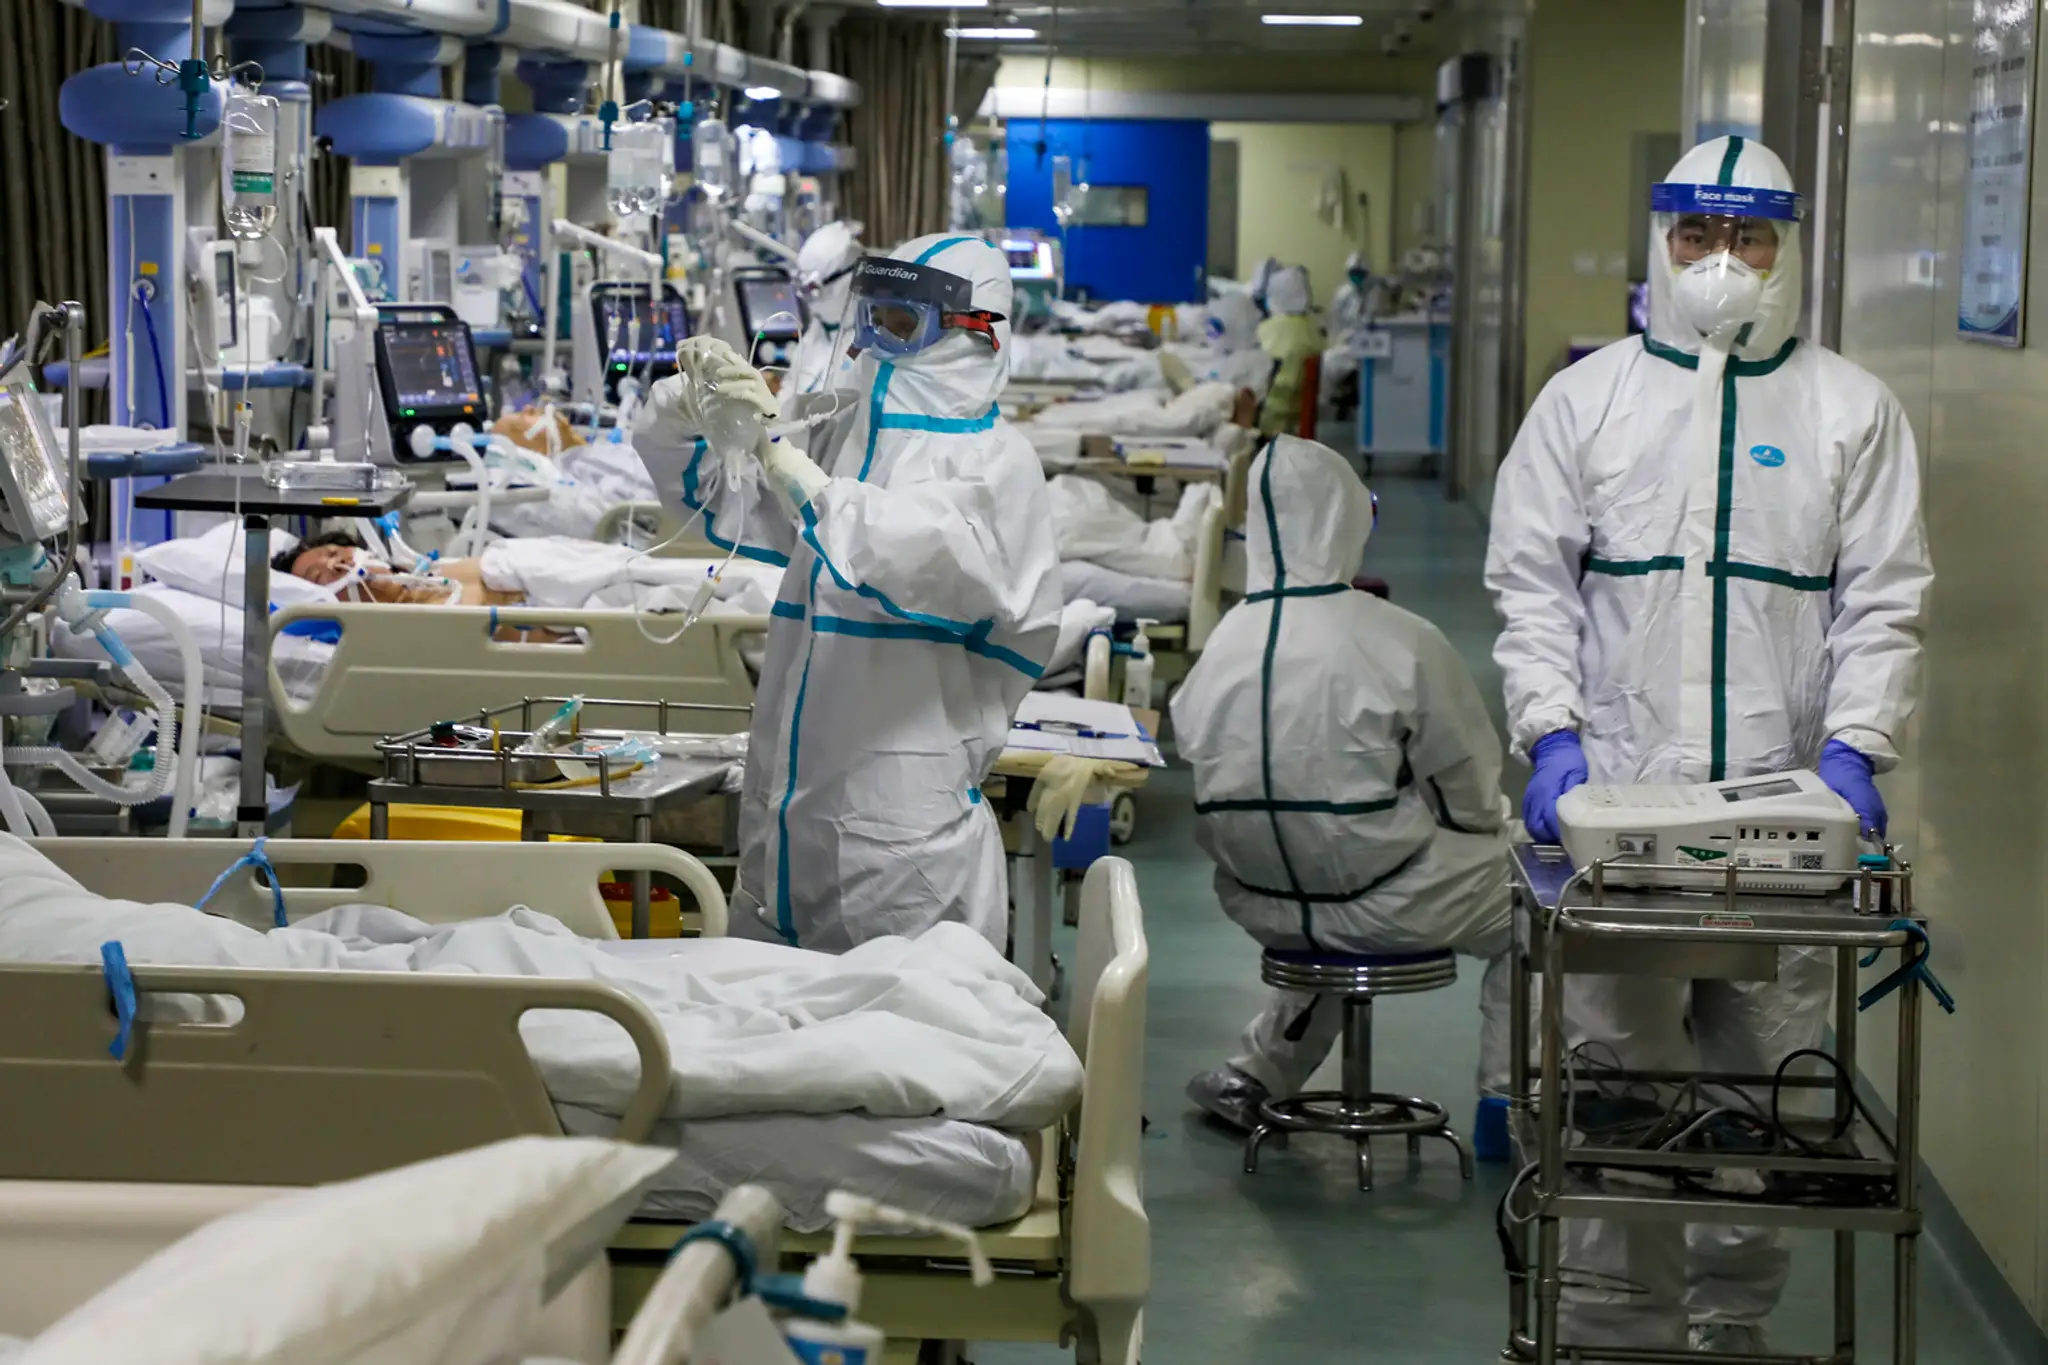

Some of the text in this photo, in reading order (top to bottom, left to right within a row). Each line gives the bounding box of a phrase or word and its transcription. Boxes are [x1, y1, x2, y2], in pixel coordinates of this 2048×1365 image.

[1693, 189, 1755, 204] Face mask
[865, 263, 919, 281] Guardian
